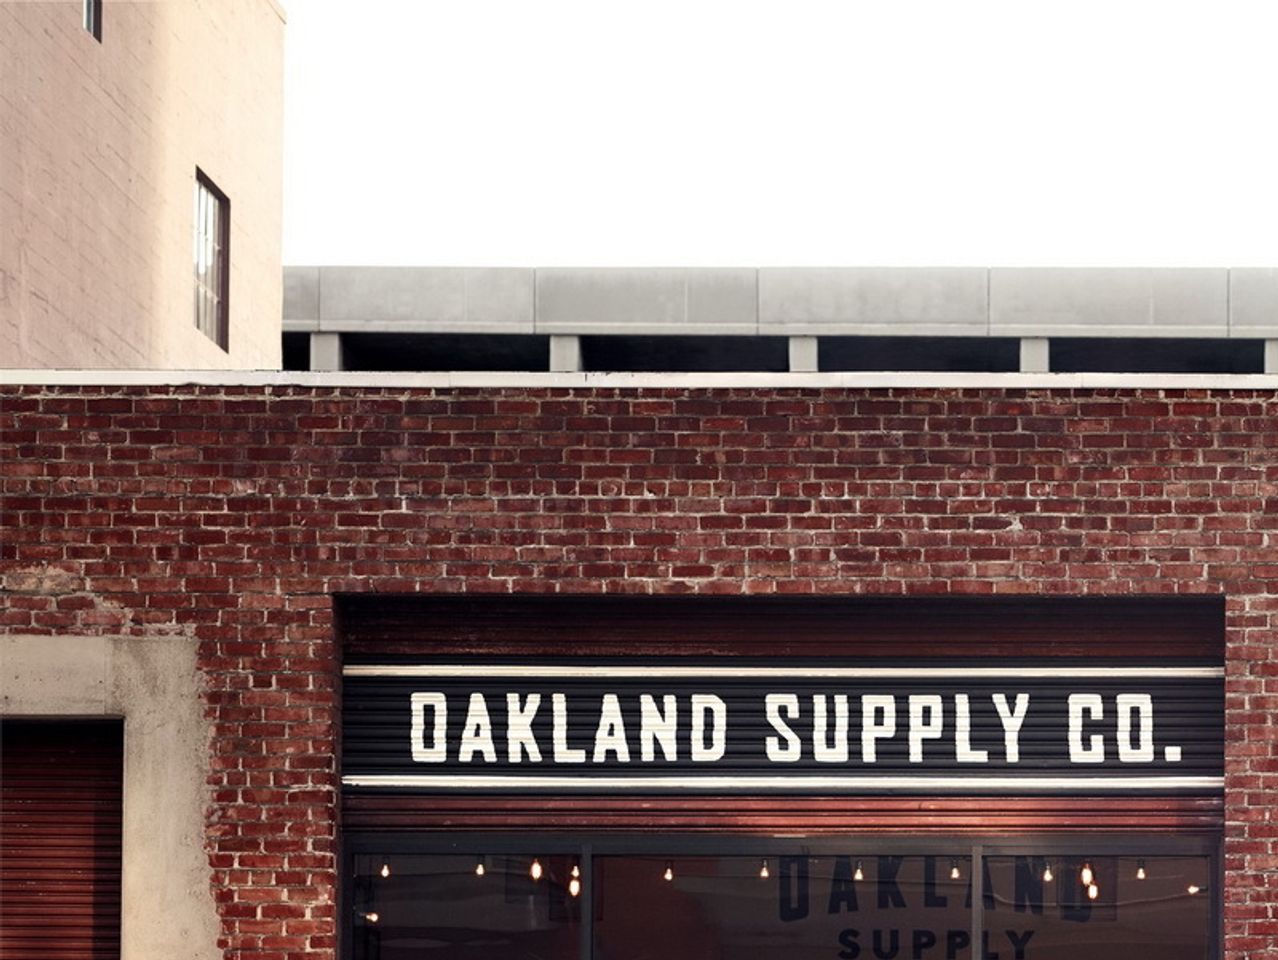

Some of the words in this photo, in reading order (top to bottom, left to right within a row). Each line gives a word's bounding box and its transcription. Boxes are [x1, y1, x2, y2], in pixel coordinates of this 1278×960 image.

[410, 692, 727, 763] OAKLAND
[765, 693, 1030, 763] SUPPLY
[1067, 693, 1182, 763] CO.
[838, 929, 1035, 960] SUPPLY
